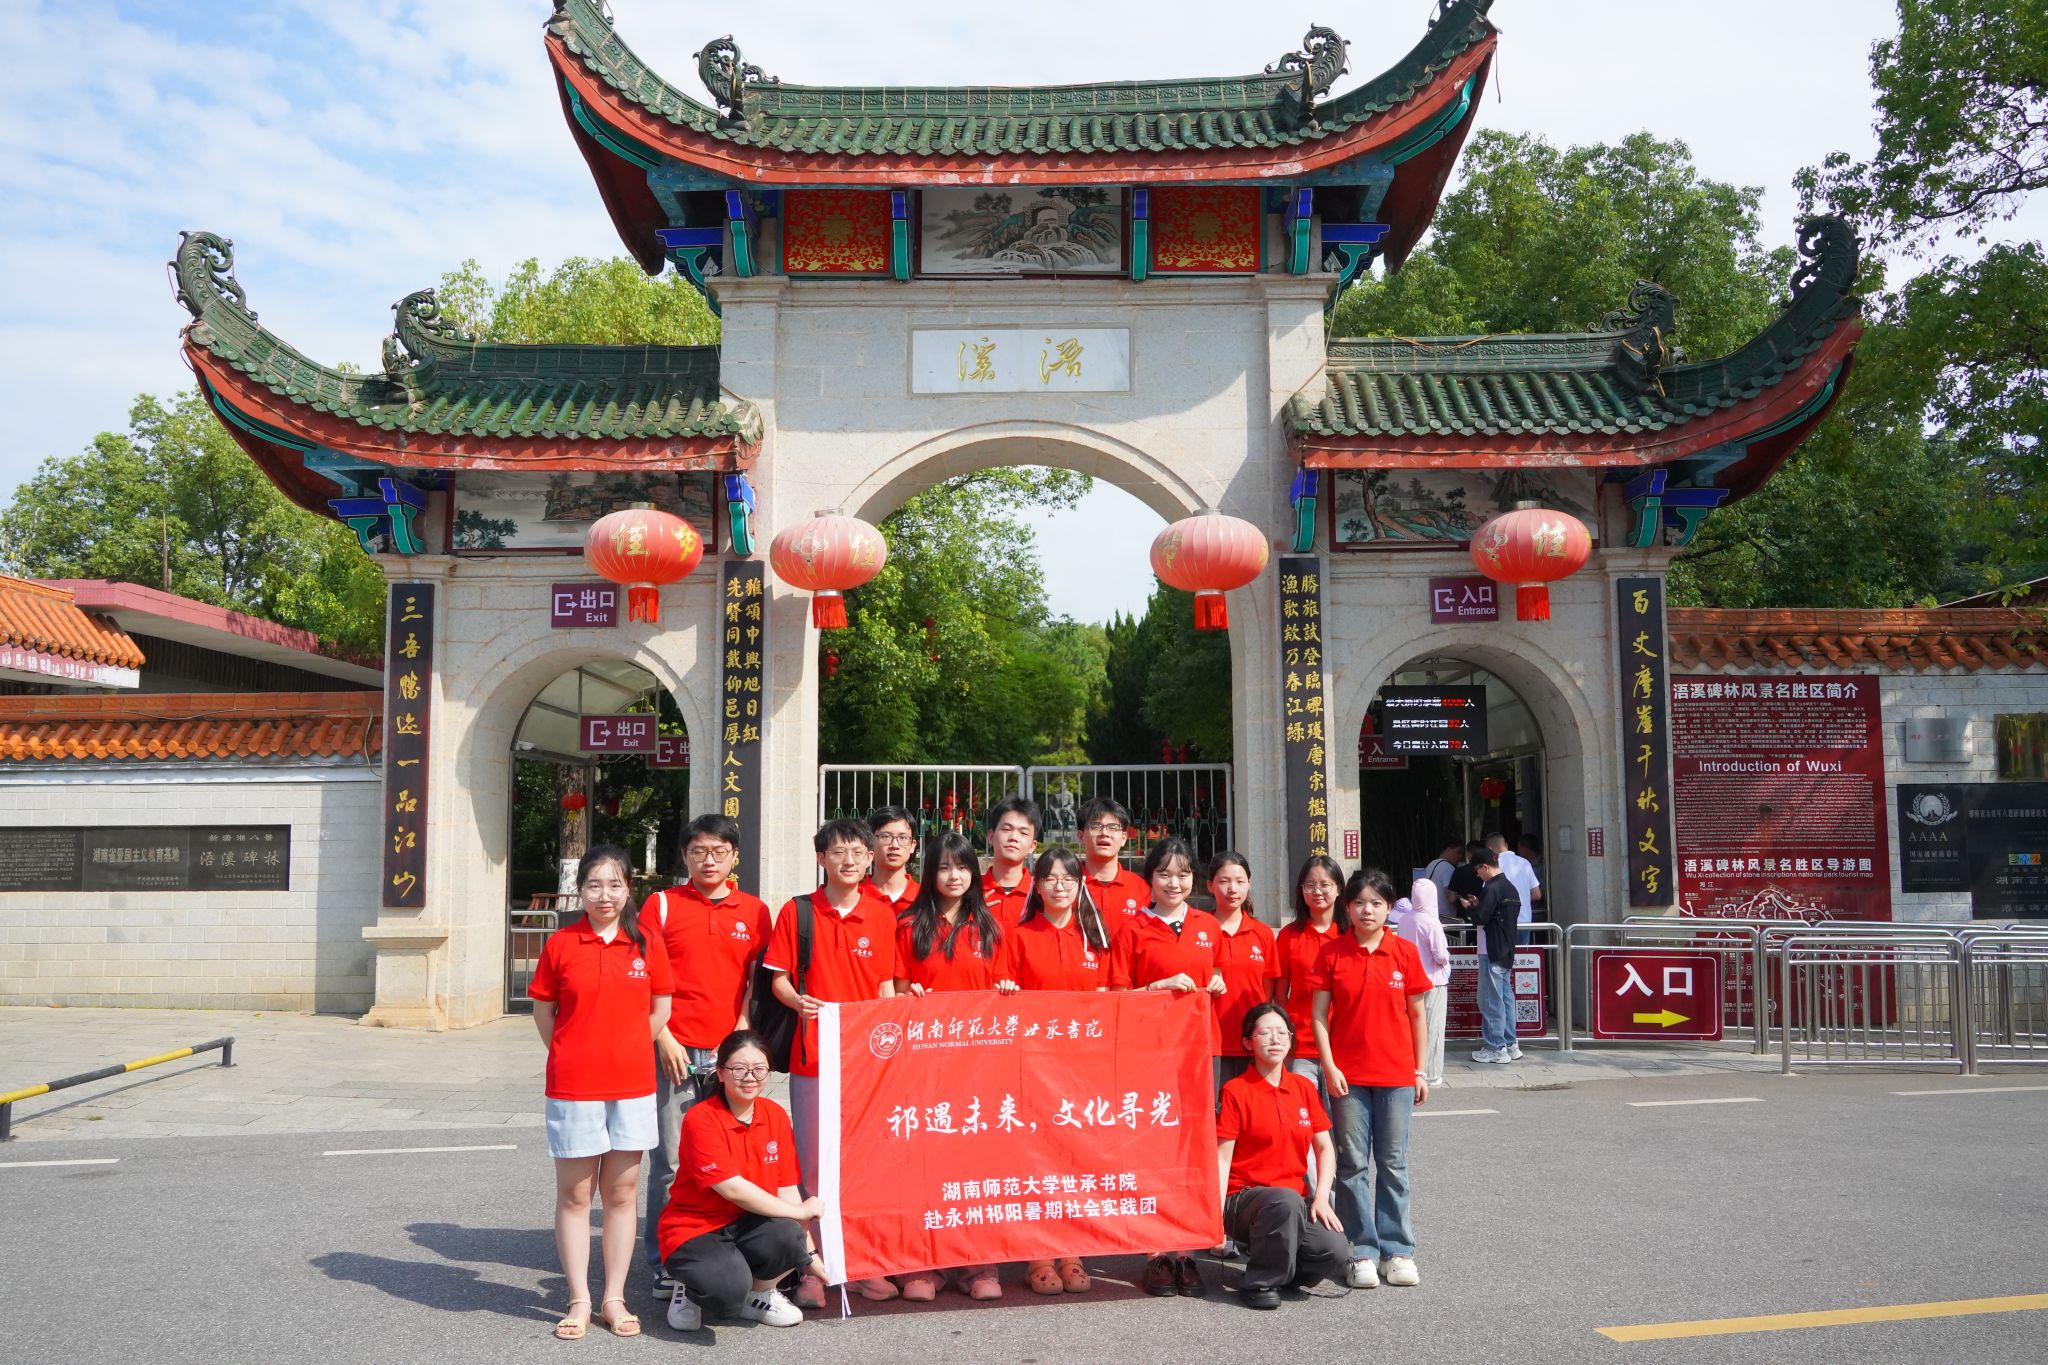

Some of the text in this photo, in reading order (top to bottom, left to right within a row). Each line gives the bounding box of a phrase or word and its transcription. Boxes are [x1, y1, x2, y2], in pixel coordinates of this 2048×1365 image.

[580, 589, 615, 609] 出口
[1461, 585, 1493, 604] 入口
[585, 612, 608, 622] Exit
[1458, 605, 1496, 616] Entrance
[1673, 682, 1859, 700] 浯溪碑林风景名胜区简介
[617, 721, 645, 736] 出口
[623, 739, 639, 747] Exit
[1371, 742, 1384, 755] 入
[1368, 755, 1399, 763] Entrance
[1699, 760, 1842, 772] Introduction of Wuxi
[1908, 831, 1948, 841] AAAA
[1684, 858, 1872, 872] 浯溪碑林风景名胜区导游图
[1615, 962, 1693, 996] 入口
[912, 1038, 1014, 1051] HUNAN NORMAL UNIVERSITY
[942, 1172, 1138, 1201] 湖南师范大学世承书院
[924, 1196, 1157, 1230] 赴永州祁阳暑期社会实践团
